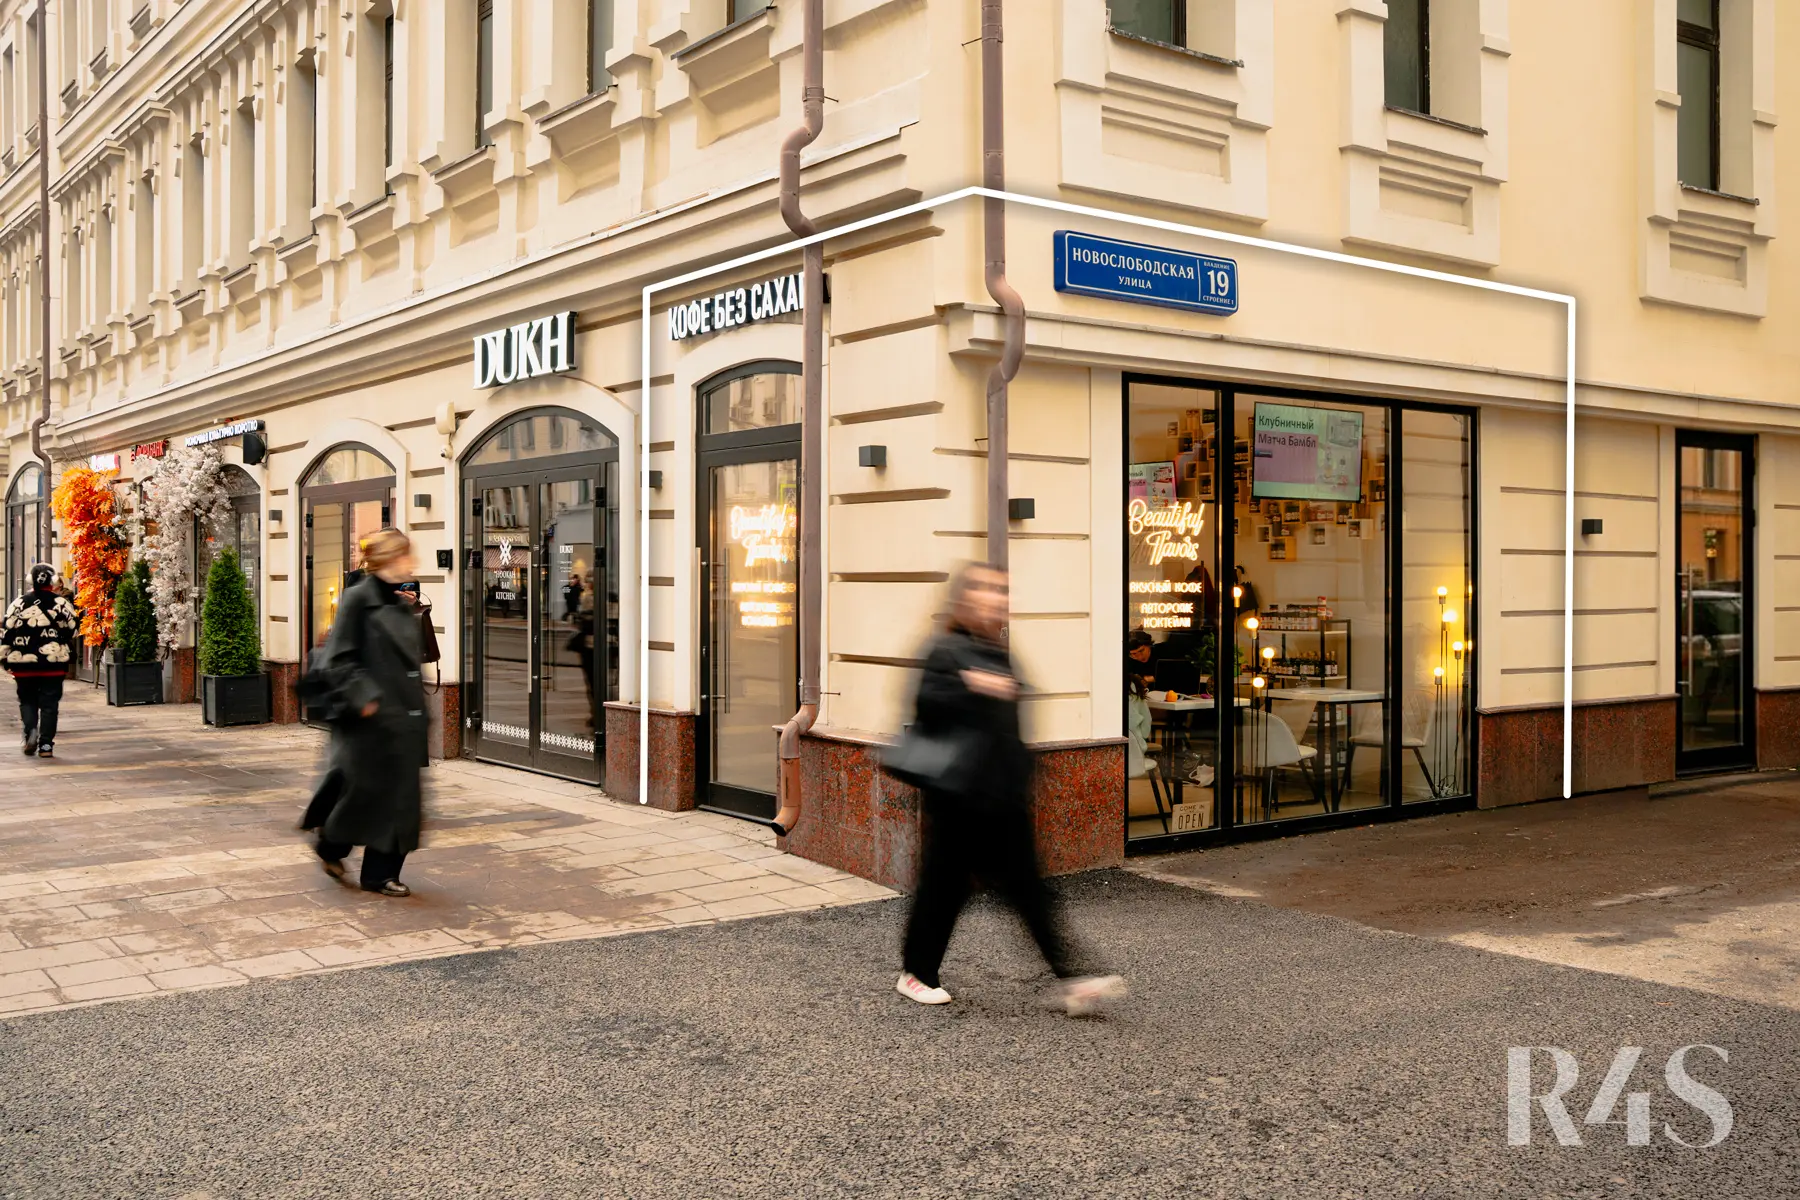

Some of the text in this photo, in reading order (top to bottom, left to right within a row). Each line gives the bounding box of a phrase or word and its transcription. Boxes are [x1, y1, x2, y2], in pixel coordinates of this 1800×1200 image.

[1073, 247, 1195, 280] НОВОСЛОБОДСКАЯ
[1118, 275, 1152, 290] УЛИЦА
[1207, 270, 1229, 297] 19
[1203, 295, 1230, 304] СТРОЕНИЕ
[668, 297, 711, 341] КОФЕ
[714, 287, 747, 330] БЕЗ
[473, 311, 577, 390] DUKH
[1259, 415, 1314, 430] Клубничный
[1259, 433, 1316, 448] Матча Бамбл
[1128, 499, 1205, 536] Beautiful
[1146, 531, 1199, 565] Flavors
[1129, 580, 1203, 593] ВКУСНЫЙ КОФЕ
[495, 591, 516, 600] KITCHEN
[1141, 602, 1194, 614] АВТОРСКИЕ
[1143, 615, 1191, 628] КОКТЕЙЛИ
[40, 628, 58, 638] AQ
[1178, 812, 1204, 830] OPEN
